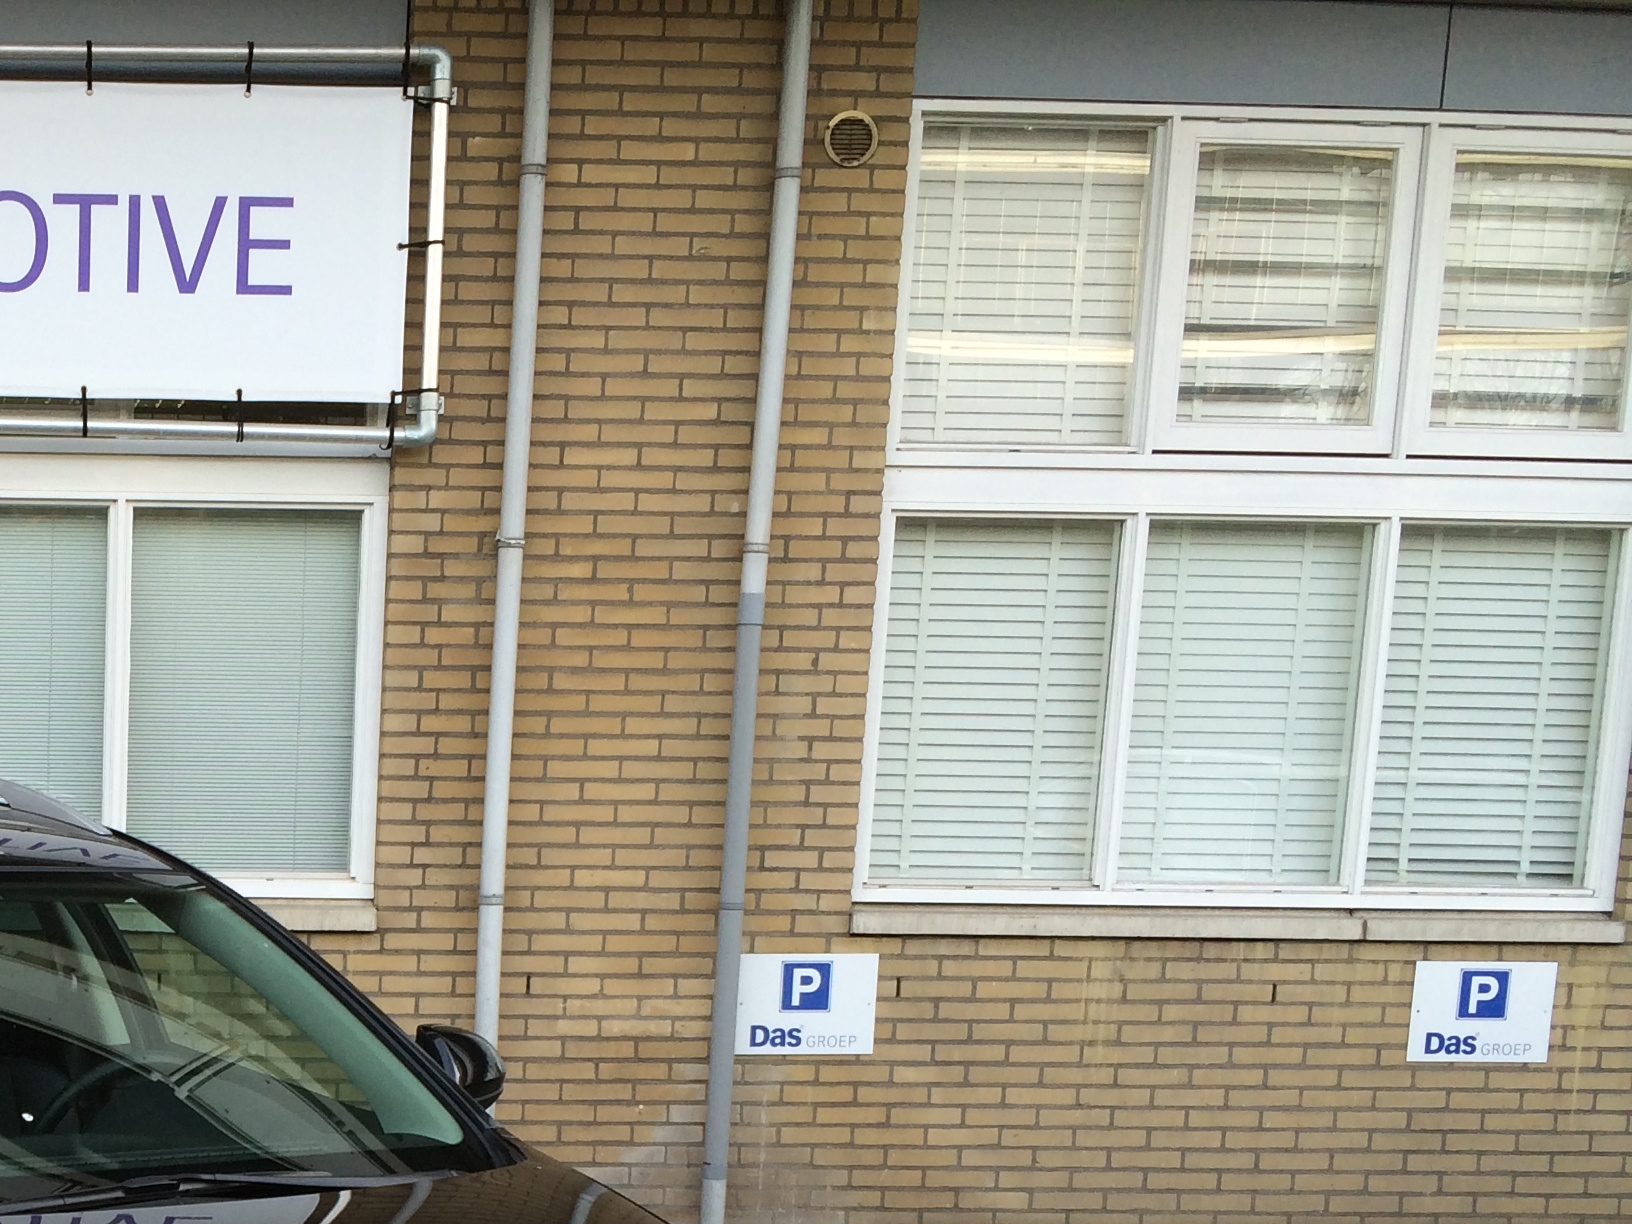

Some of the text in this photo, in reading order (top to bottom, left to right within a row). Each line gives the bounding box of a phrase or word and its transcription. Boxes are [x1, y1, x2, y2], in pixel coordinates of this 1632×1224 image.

[791, 968, 822, 1007] P
[1468, 976, 1500, 1014] P
[749, 1025, 857, 1048] Das GROEP
[1424, 1032, 1532, 1056] Das GROEP
